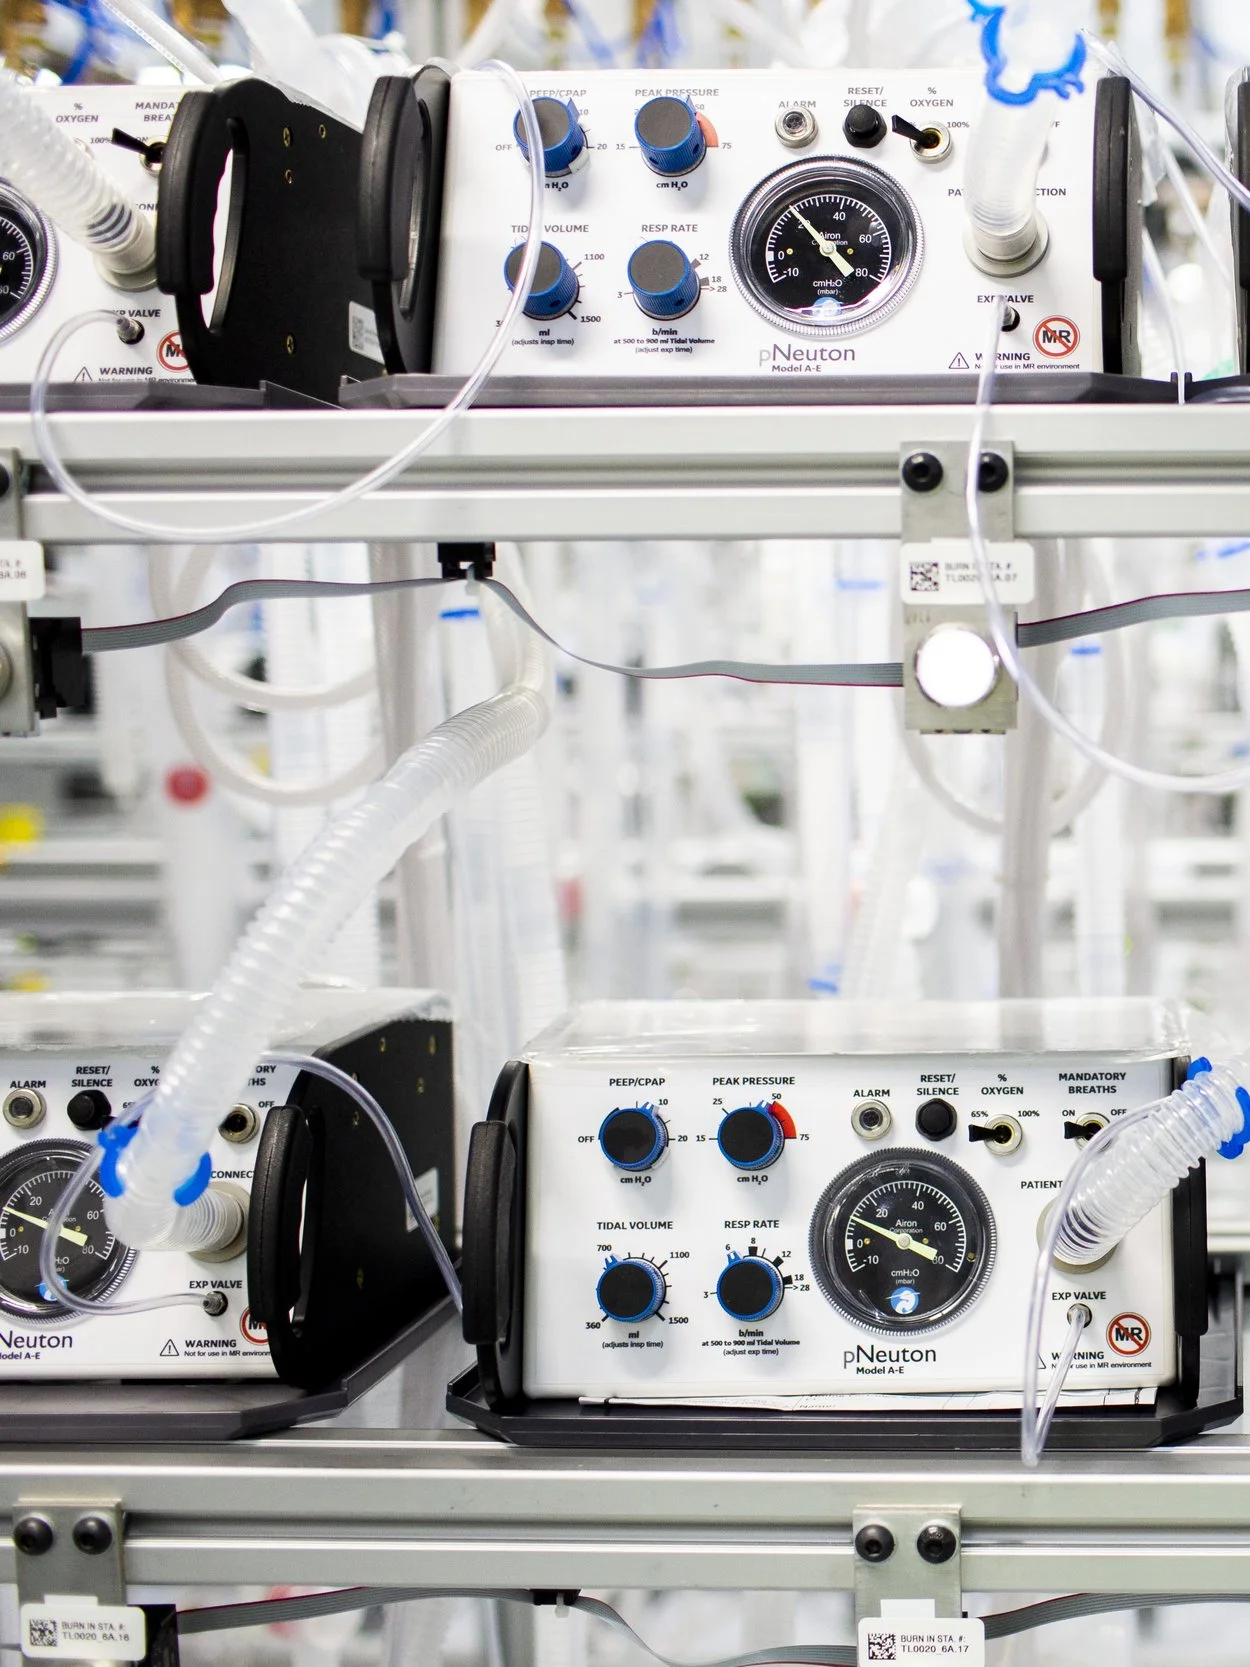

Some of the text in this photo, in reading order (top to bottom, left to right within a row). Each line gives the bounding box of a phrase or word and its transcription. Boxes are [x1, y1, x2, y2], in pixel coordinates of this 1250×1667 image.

[848, 87, 883, 95] RESET/
[56, 115, 98, 123] OXYGEN
[833, 212, 845, 220] 40
[3, 252, 15, 261] 60
[129, 309, 161, 318] VALVE
[1042, 331, 1071, 343] MR
[760, 344, 854, 366] pNeuton
[76, 1066, 110, 1075] RESET/
[743, 1077, 795, 1085] PRESSURE
[921, 1074, 955, 1083] RESET/
[1059, 1073, 1126, 1081] MANDATORY
[72, 1079, 112, 1087] SILENCE
[610, 1078, 665, 1087] PEEP/CPAP
[854, 1089, 890, 1097] ALARM
[917, 1088, 959, 1096] SILENCE
[981, 1087, 1023, 1095] OXYGEN
[1069, 1086, 1116, 1094] BREATHS
[30, 1196, 42, 1205] 20
[912, 1202, 924, 1210] 40
[87, 1211, 99, 1220] 60
[876, 1209, 888, 1217] 20
[597, 1221, 673, 1230] TIDAL VOLUME
[753, 1220, 779, 1228] RATE
[896, 1219, 917, 1227] Airon
[189, 1280, 208, 1289] EXP
[739, 1329, 763, 1337] b/min
[1116, 1327, 1143, 1341] MR
[185, 1340, 236, 1348] WARNING
[844, 1345, 936, 1369] pNeuton
